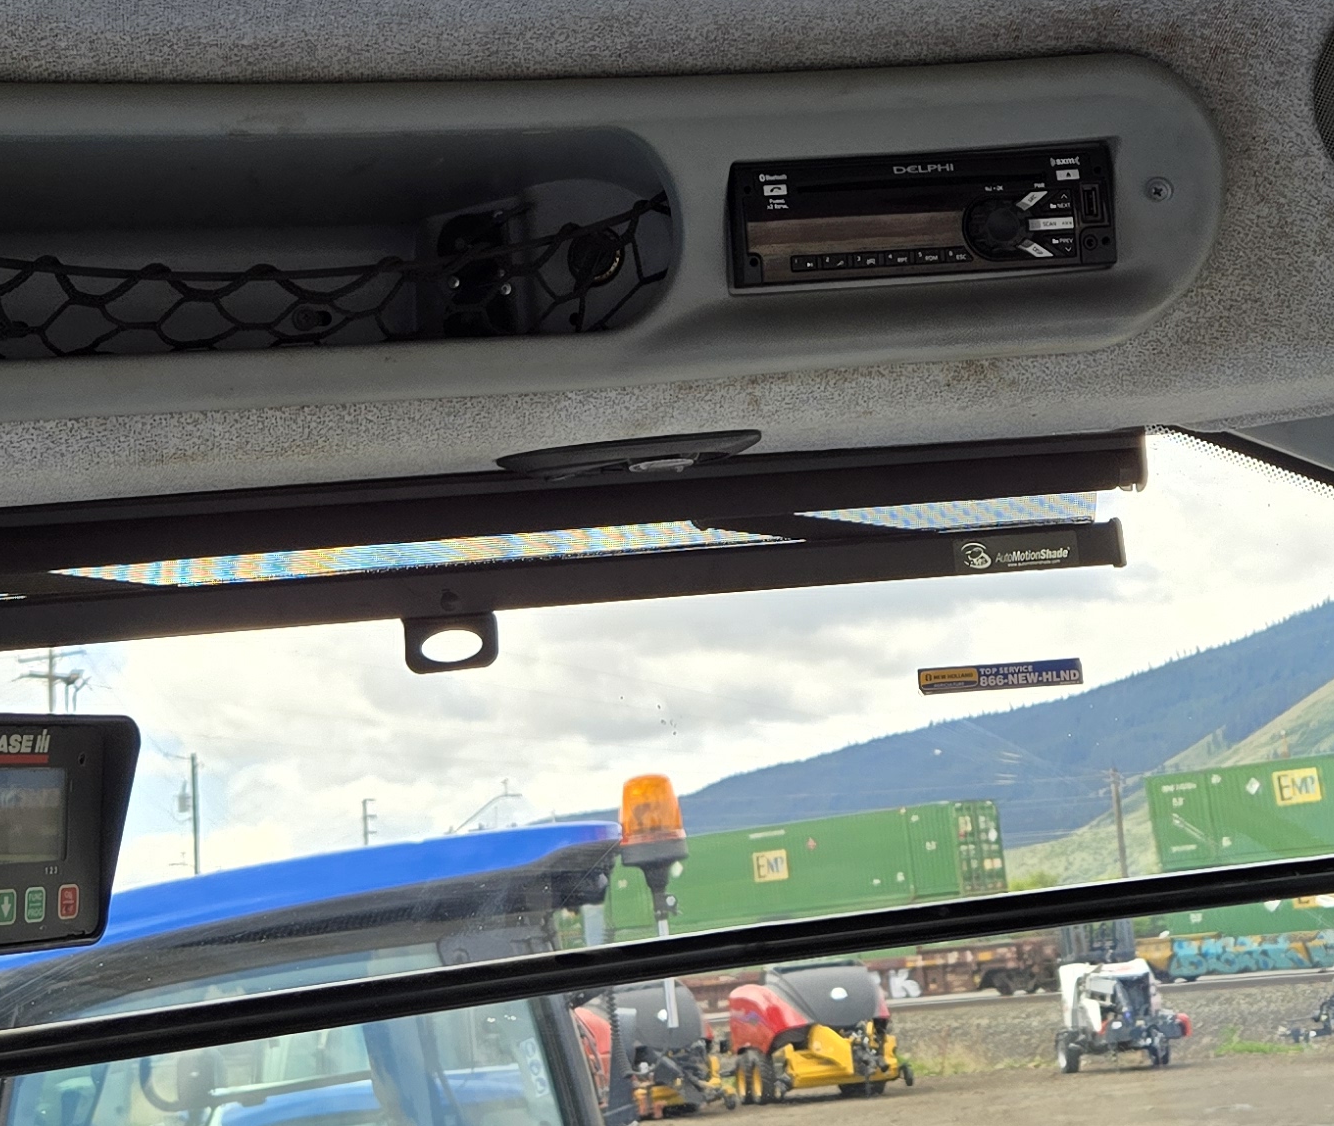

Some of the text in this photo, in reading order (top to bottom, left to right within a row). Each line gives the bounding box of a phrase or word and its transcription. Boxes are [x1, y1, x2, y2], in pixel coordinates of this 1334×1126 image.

[893, 163, 954, 174] DELPHI
[995, 547, 1068, 563] AutoMotionShade
[947, 672, 974, 680] HOLLAND
[980, 665, 1033, 675] TOP SERVICE
[979, 670, 1080, 687] 866-NEW-HLND
[1277, 774, 1316, 802] EMP
[756, 855, 784, 879] EMP
